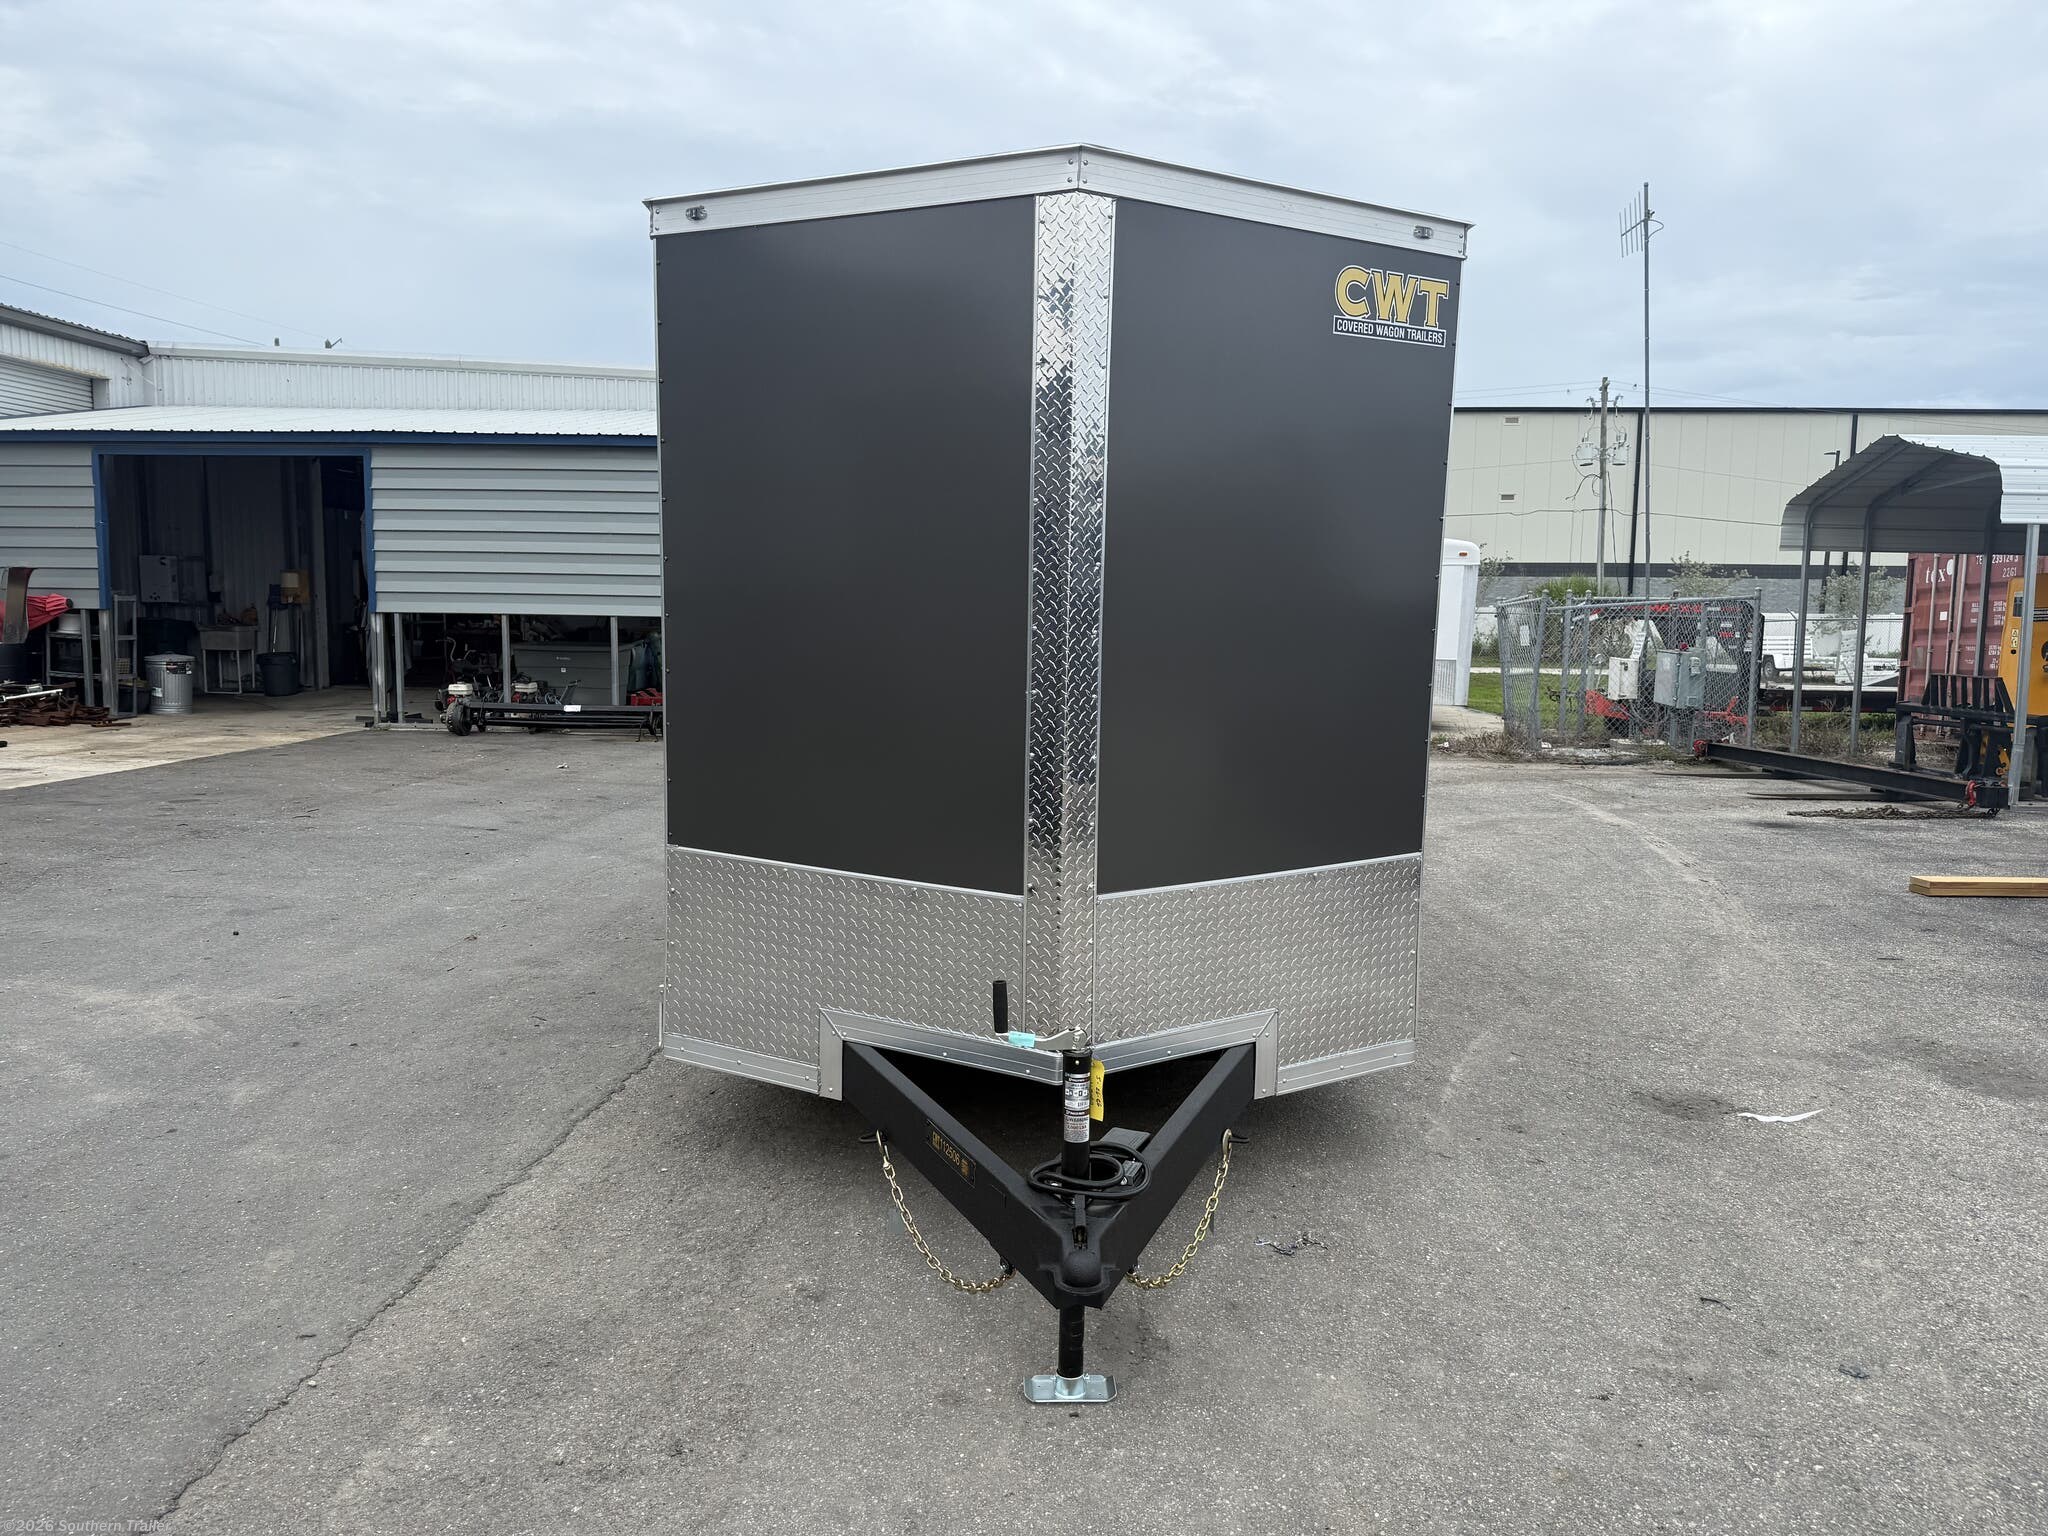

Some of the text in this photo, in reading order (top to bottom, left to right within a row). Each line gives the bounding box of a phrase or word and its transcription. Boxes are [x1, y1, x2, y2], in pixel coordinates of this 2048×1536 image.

[1335, 265, 1449, 329] CWT
[1336, 319, 1443, 344] COVERED WAGON TRAILERS
